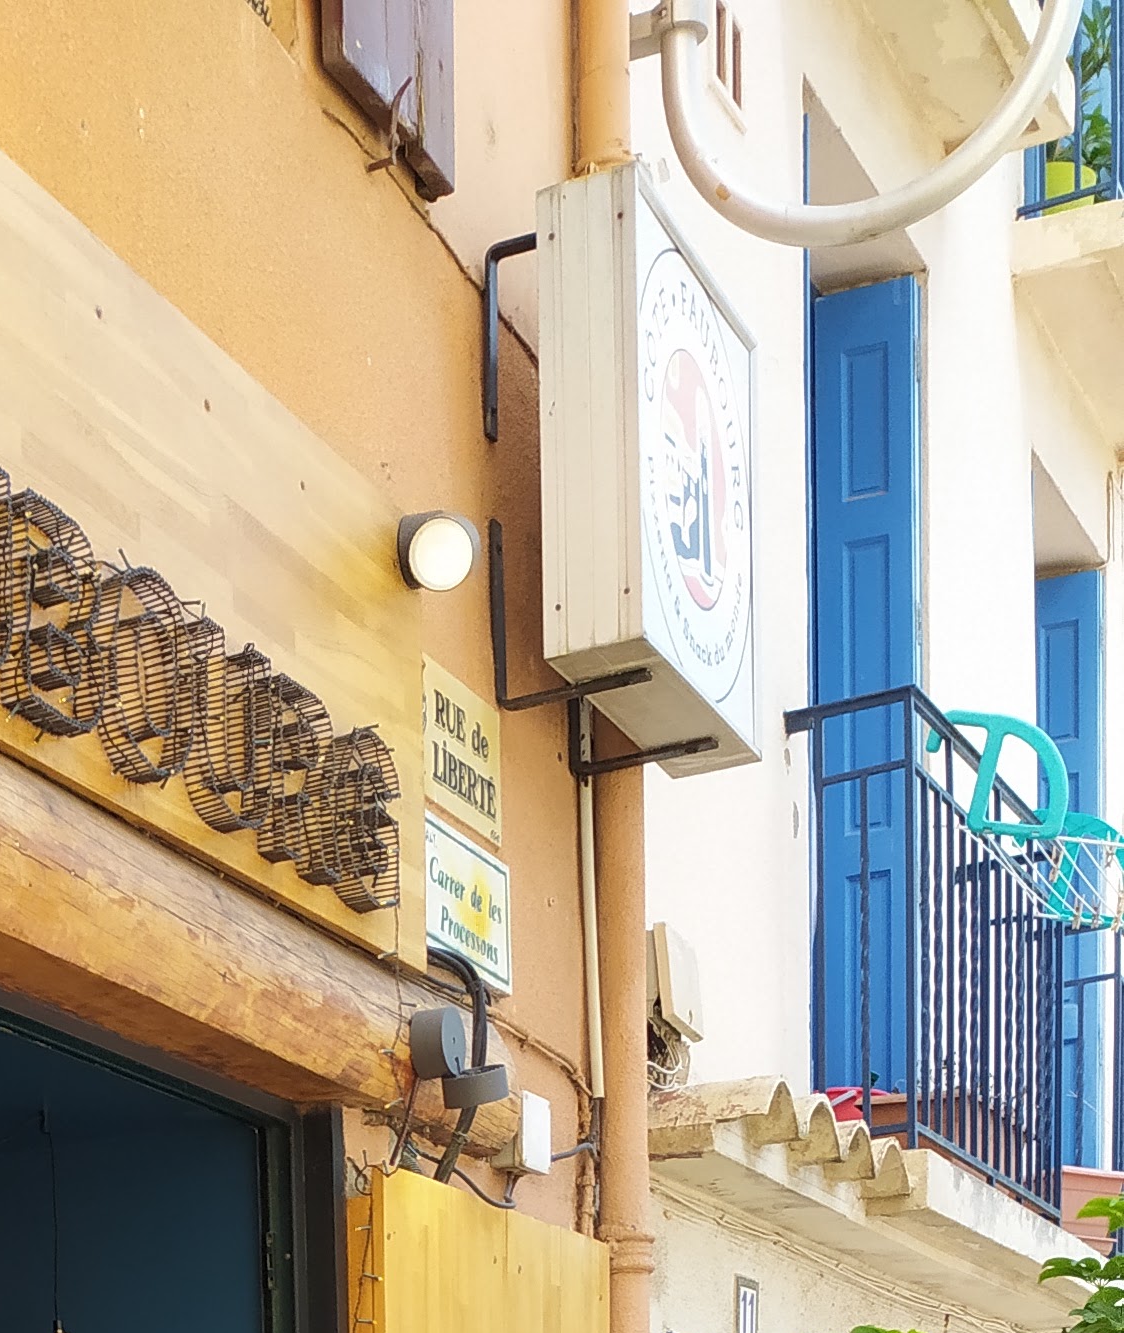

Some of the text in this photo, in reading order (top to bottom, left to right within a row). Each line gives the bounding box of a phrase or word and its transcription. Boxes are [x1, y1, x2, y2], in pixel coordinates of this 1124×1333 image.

[433, 688, 490, 760] RUE de
[429, 856, 503, 925] Carrer de les
[440, 905, 499, 966] Processons
